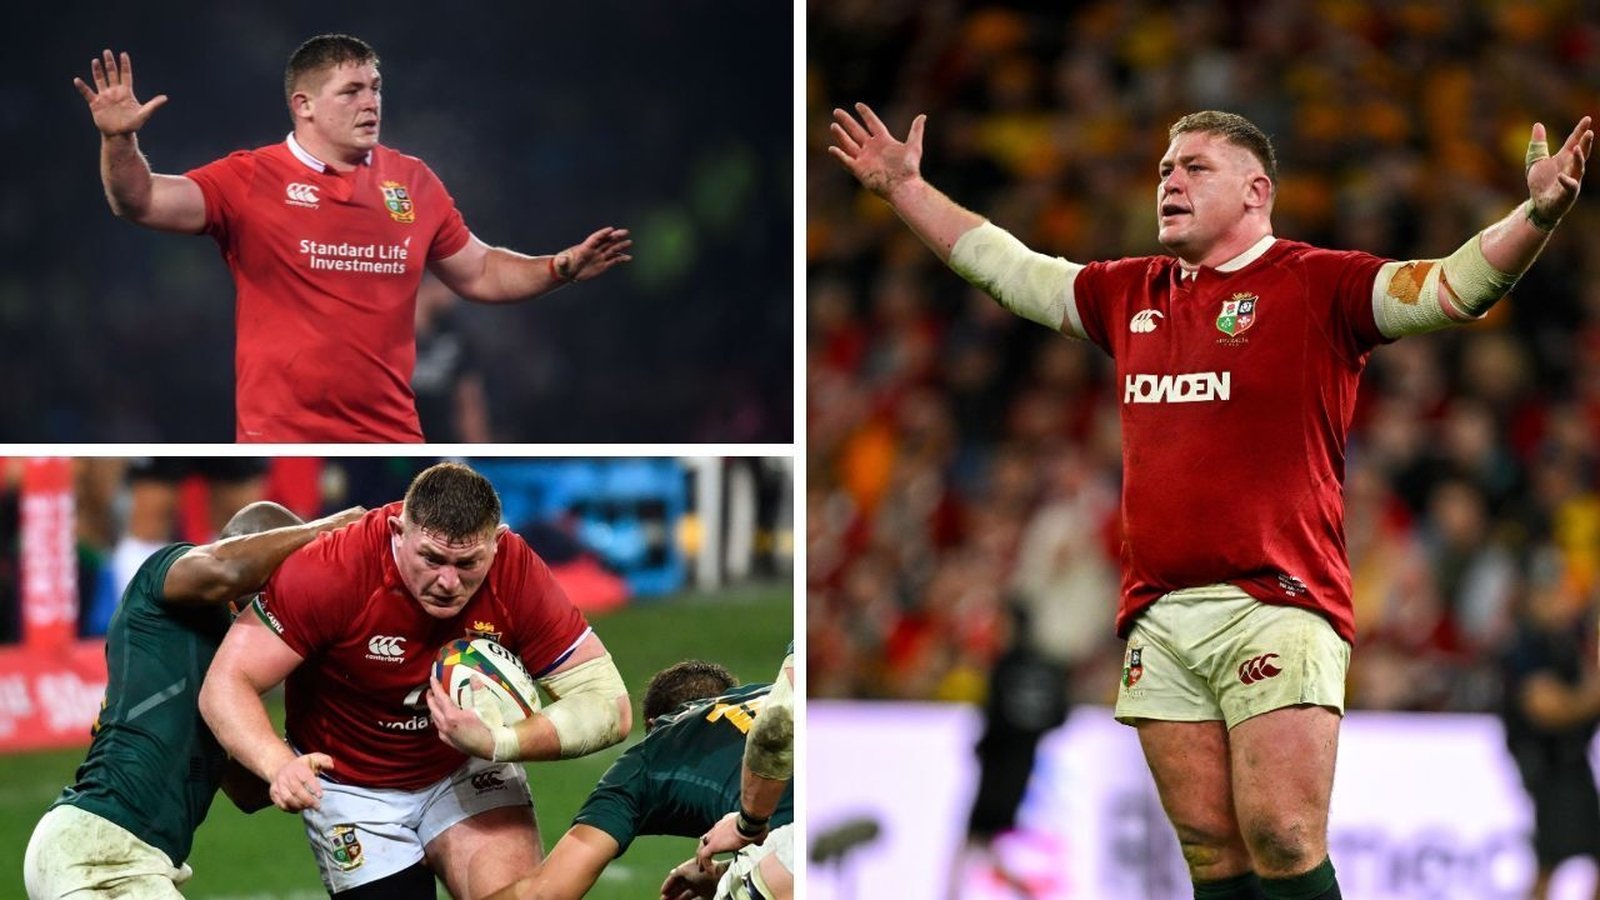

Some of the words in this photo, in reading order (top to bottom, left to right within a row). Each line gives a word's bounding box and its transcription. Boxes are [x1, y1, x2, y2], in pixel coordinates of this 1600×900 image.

[300, 239, 375, 258] Standard
[379, 245, 408, 259] Life
[310, 255, 406, 274] Investments
[1124, 371, 1231, 404] HOWDEN
[266, 611, 285, 634] CASTLE
[377, 715, 429, 731] voda
